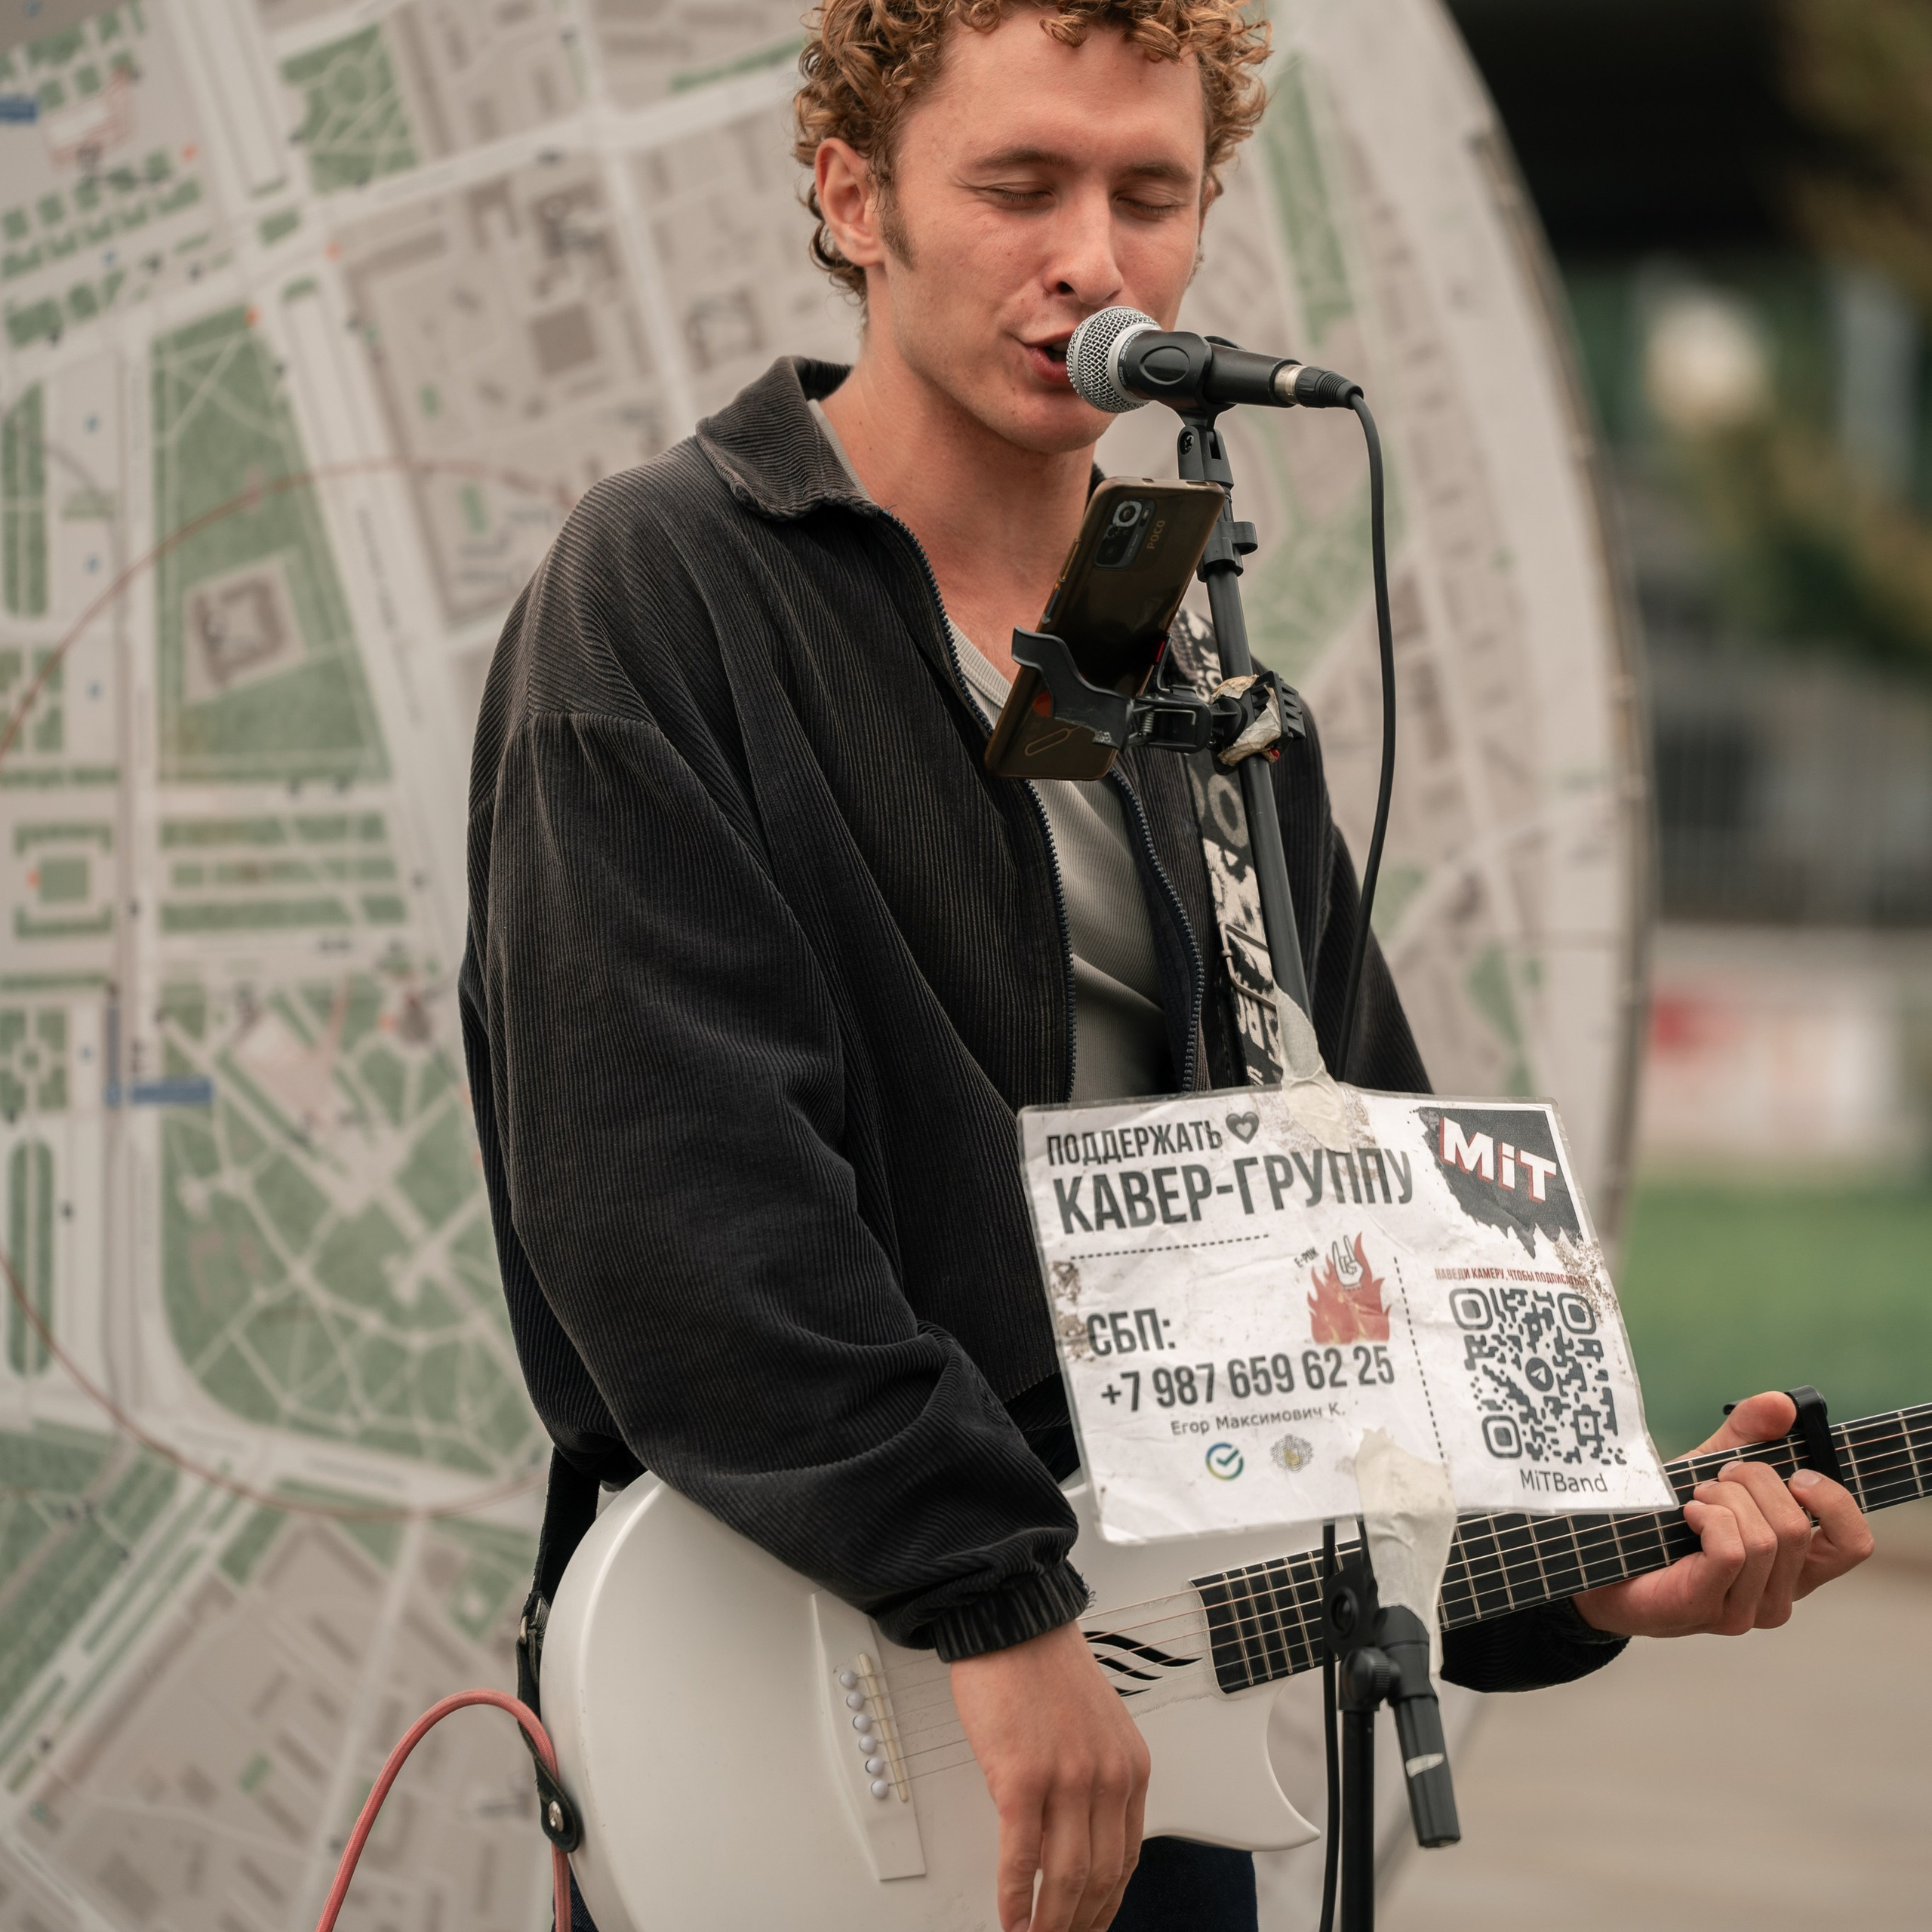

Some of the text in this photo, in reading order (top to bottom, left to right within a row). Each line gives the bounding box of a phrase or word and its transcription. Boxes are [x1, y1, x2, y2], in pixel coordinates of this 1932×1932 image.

[1146, 520, 1165, 549] POCO
[1046, 1120, 1223, 1167] ПОДДЕРЖАТЬ
[1438, 1115, 1557, 1203] MiT
[1052, 1148, 1414, 1235] КАВЕР-ГРУППУ
[1435, 1268, 1470, 1281] НАВЕДИ
[1509, 1269, 1535, 1282] ЧТОБЫ
[1086, 1308, 1177, 1356] СБП:
[1101, 1345, 1395, 1412] +7 987 659 62 25
[1171, 1401, 1346, 1436] Егор Максимович К.
[1519, 1468, 1608, 1492] MiTBand
